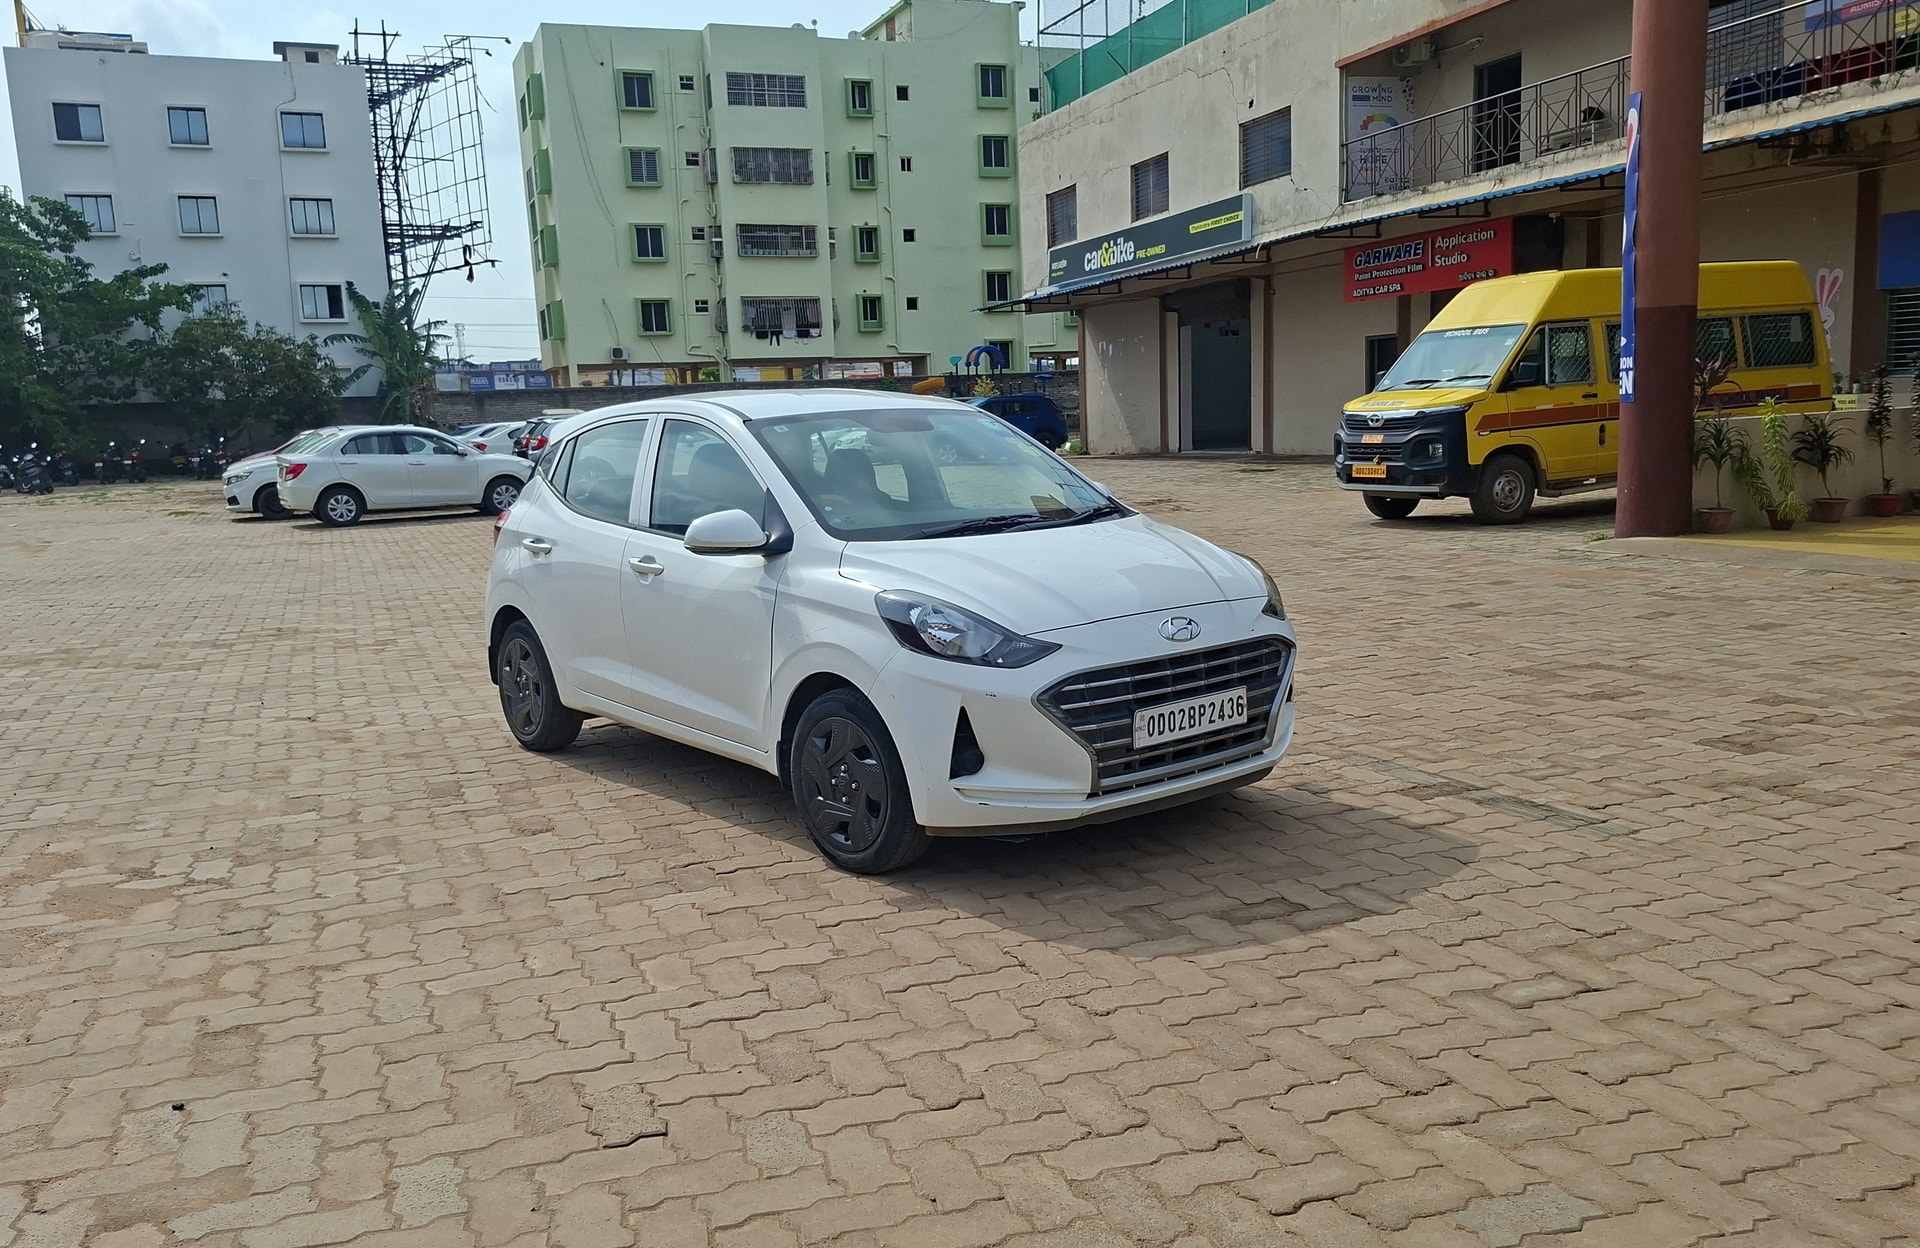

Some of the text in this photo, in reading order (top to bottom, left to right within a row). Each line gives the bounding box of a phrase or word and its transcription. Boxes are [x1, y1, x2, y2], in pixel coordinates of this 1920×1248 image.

[1352, 85, 1393, 94] GROWING
[1372, 95, 1393, 103] MIND
[1211, 218, 1223, 227] FIRST
[1223, 214, 1240, 223] CHOICE
[1435, 228, 1495, 250] Application
[1083, 237, 1135, 272] car&bike
[1136, 244, 1166, 259] PRE-OWNED
[1353, 240, 1424, 269] GARWARE
[1434, 251, 1468, 267] Studio
[1354, 263, 1423, 281] Paint Protection Film
[1352, 283, 1401, 297] ADITYA CAR SPA
[1444, 329, 1472, 338] SCHOOL
[1147, 695, 1244, 738] OD02BP2436
